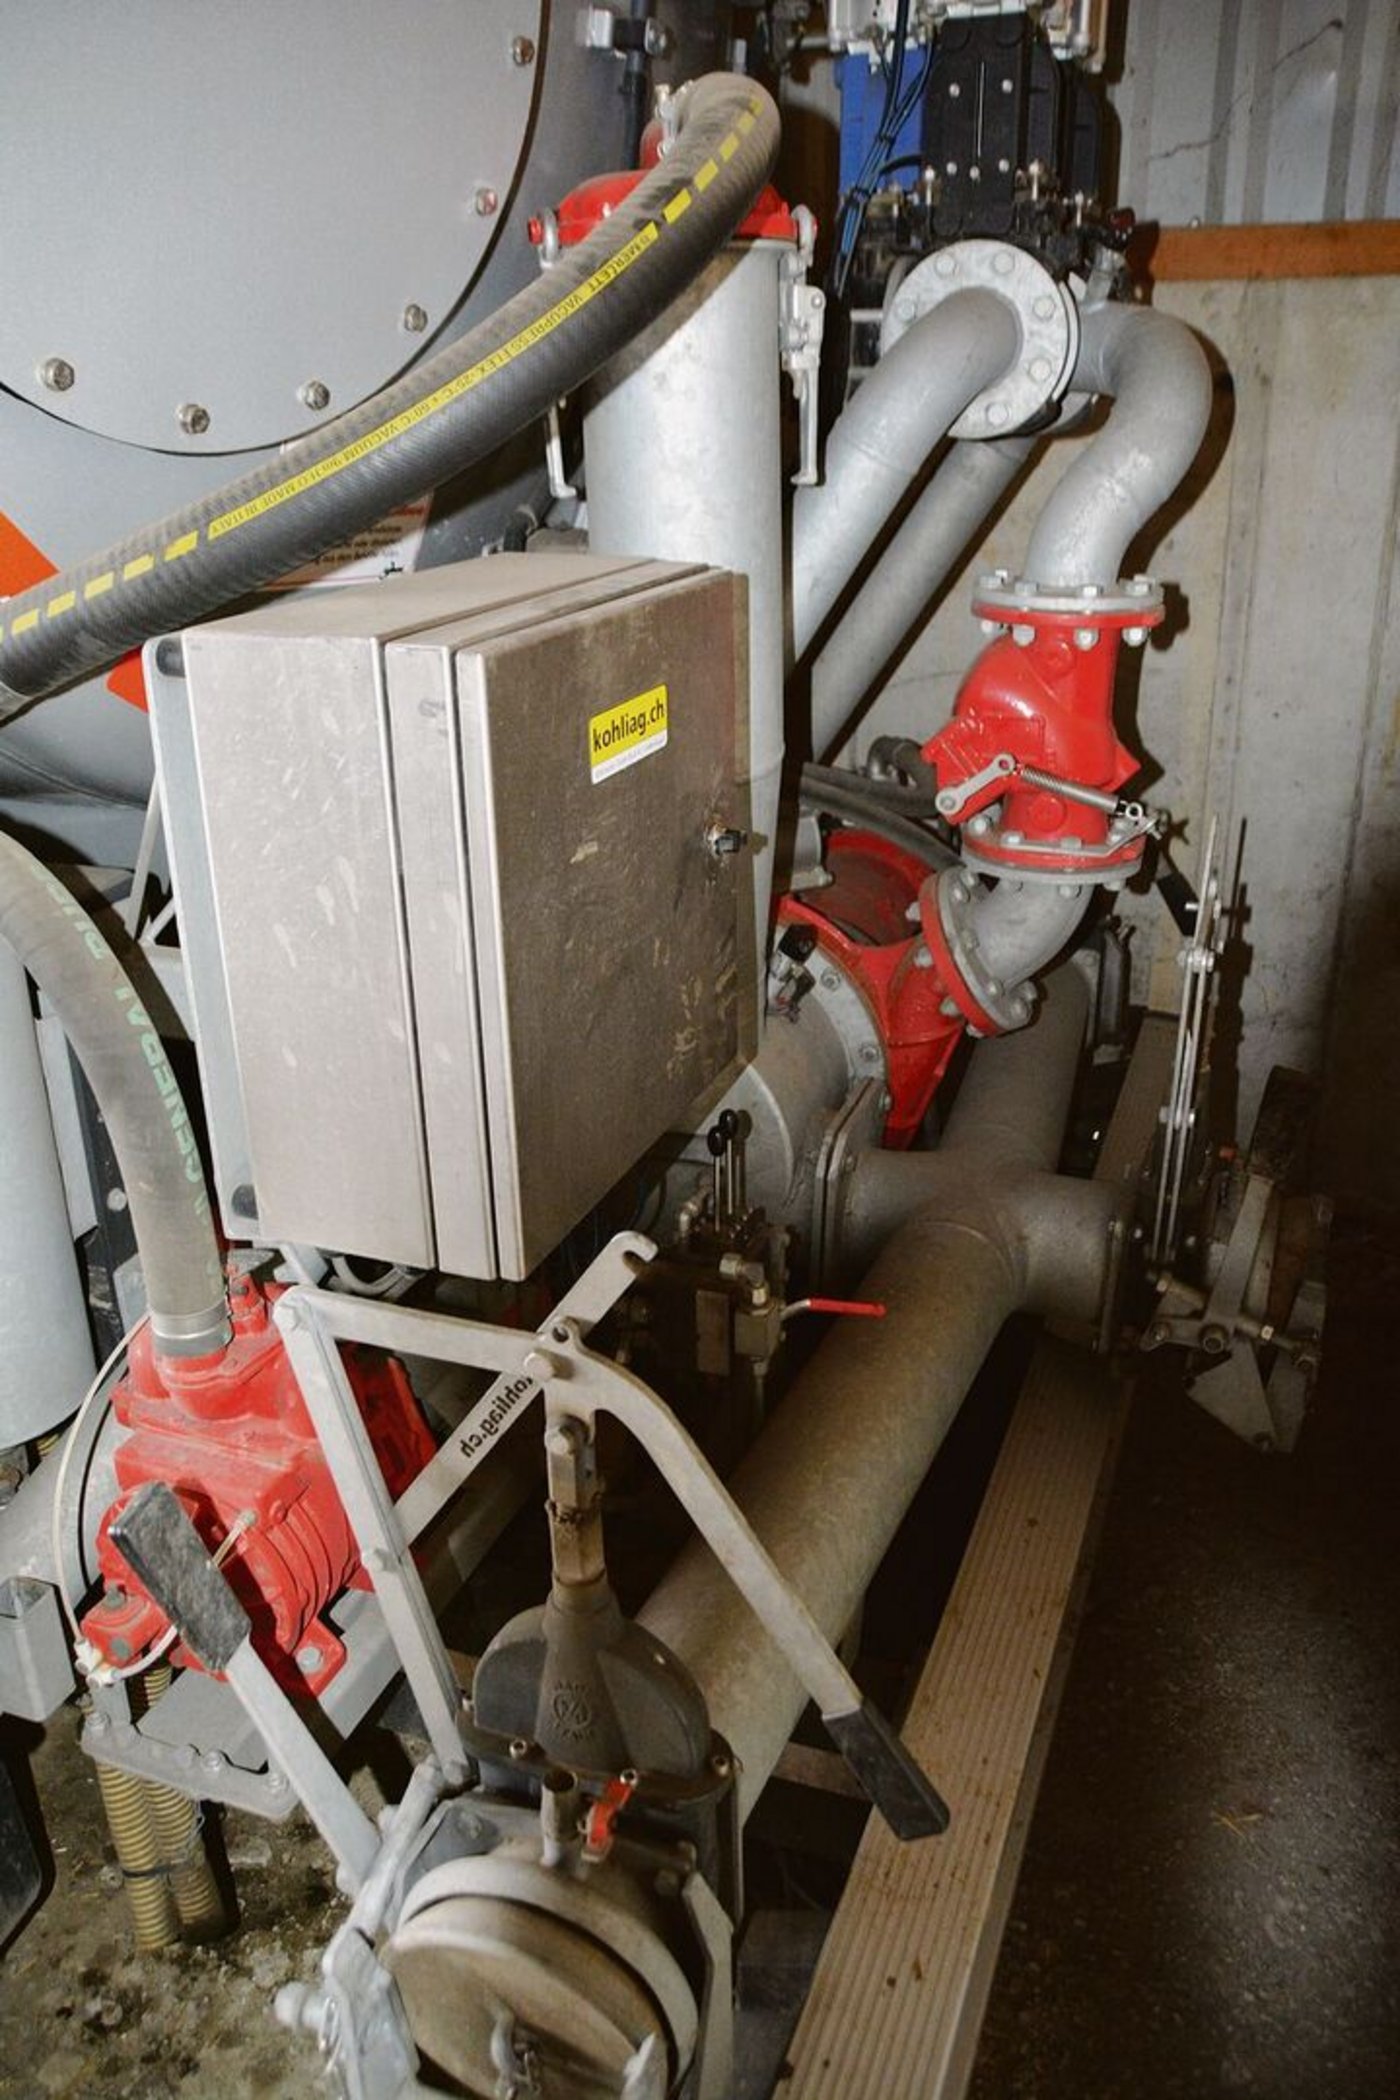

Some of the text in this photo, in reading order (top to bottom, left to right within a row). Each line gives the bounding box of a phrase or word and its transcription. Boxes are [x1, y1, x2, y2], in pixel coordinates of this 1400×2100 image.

[509, 293, 582, 351] VACUPRESS
[342, 422, 398, 461] VACUUM
[593, 698, 664, 752] kohliag.ch
